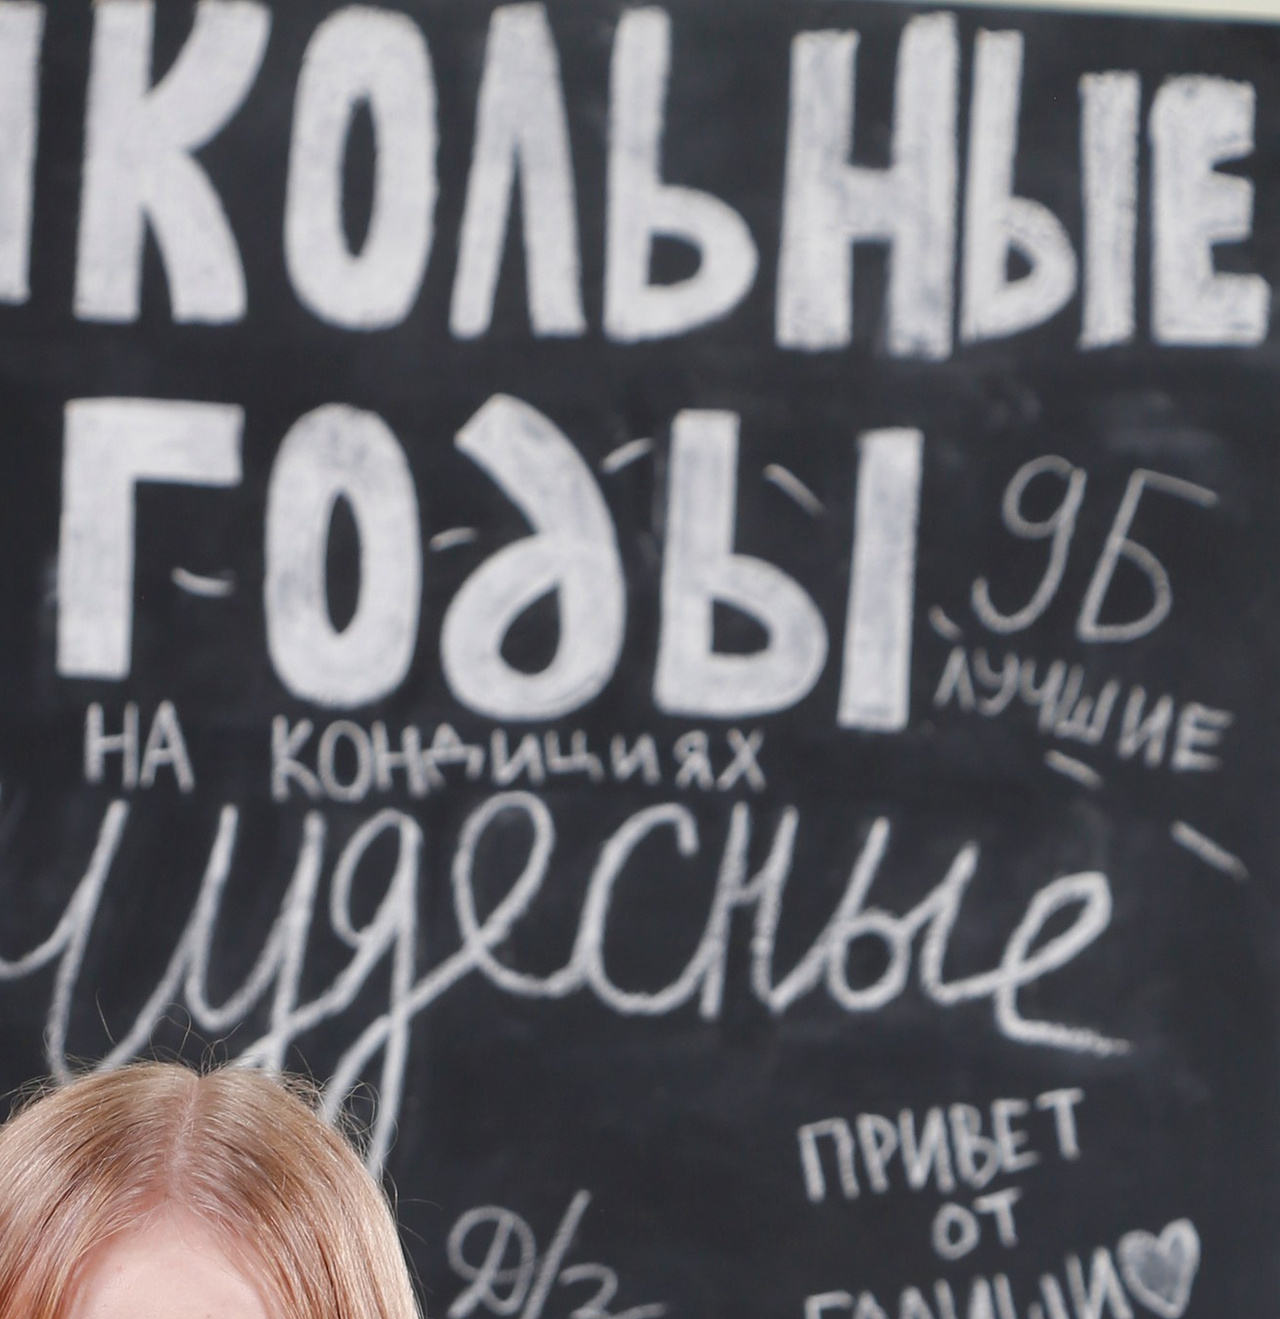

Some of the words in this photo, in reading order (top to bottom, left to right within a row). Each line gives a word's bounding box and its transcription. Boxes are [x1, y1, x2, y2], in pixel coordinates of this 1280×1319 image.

[972, 455, 1219, 642] 9Б
[85, 701, 194, 789] НА
[272, 714, 766, 801] КОНДИЦИЯХ
[933, 646, 1232, 770] ЛУЧШИЕ
[798, 1088, 1084, 1201] ПРИВЕТ
